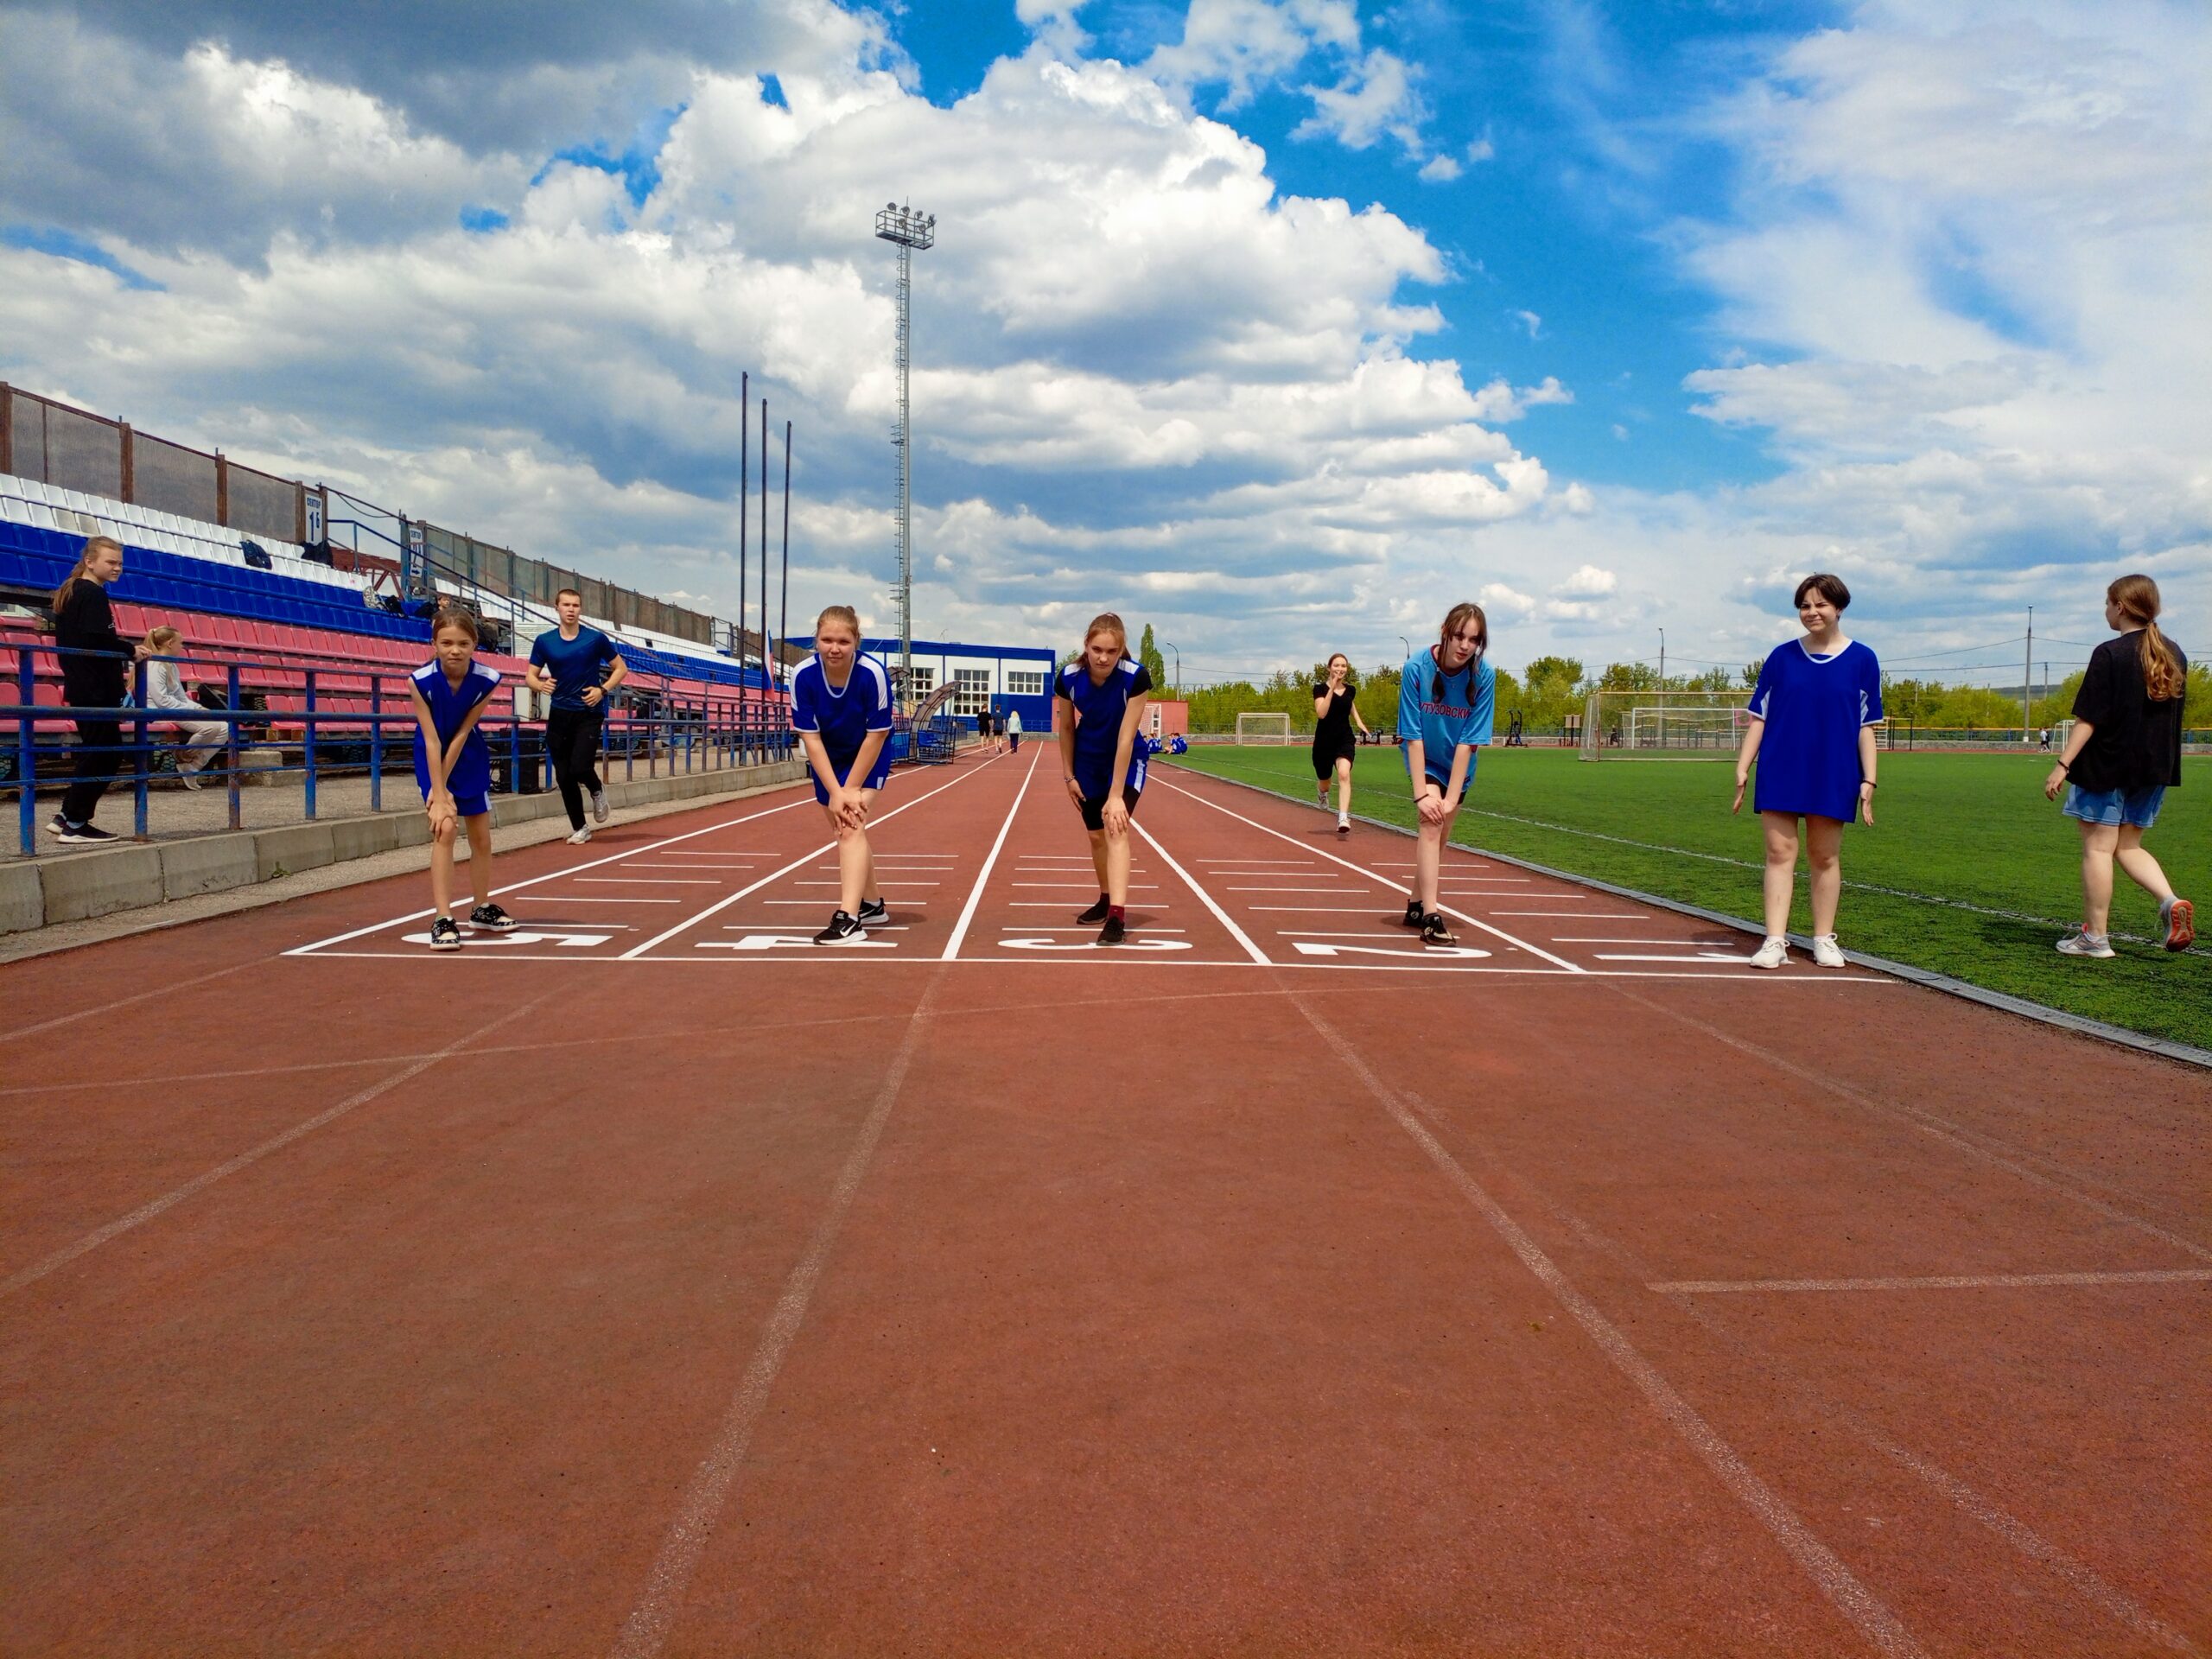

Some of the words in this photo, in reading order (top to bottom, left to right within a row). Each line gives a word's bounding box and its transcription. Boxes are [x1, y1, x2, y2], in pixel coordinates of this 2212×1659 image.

[401, 931, 613, 946] 5
[694, 935, 899, 950] 4
[997, 938, 1193, 950] 3
[1292, 943, 1492, 958] 2
